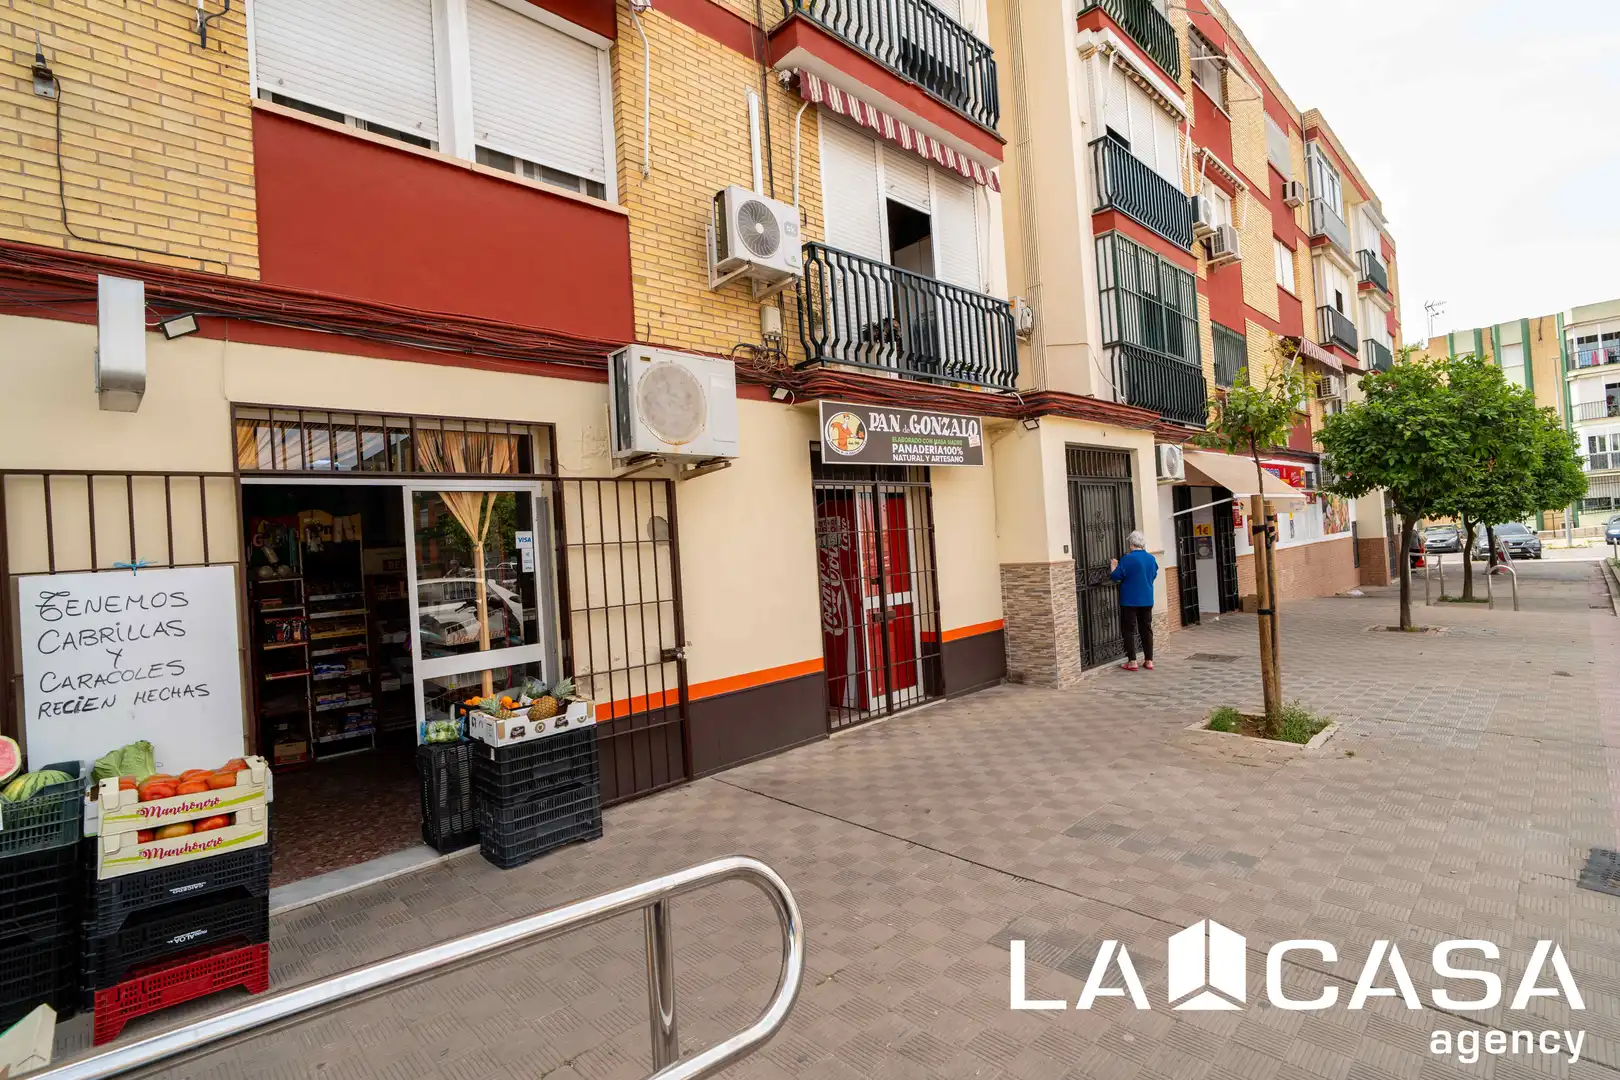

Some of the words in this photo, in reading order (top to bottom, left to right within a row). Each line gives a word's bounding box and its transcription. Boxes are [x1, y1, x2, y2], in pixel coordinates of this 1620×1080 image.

[868, 412, 901, 433] PAN
[902, 424, 911, 434] de
[909, 414, 979, 437] GONZALO
[892, 436, 922, 444] ELABORADO
[892, 454, 925, 462] NATURAL
[931, 455, 964, 463] ARTESANO
[35, 591, 189, 621] TENEMOS
[39, 659, 186, 693] CARACOLES
[133, 684, 210, 705] HECHAS
